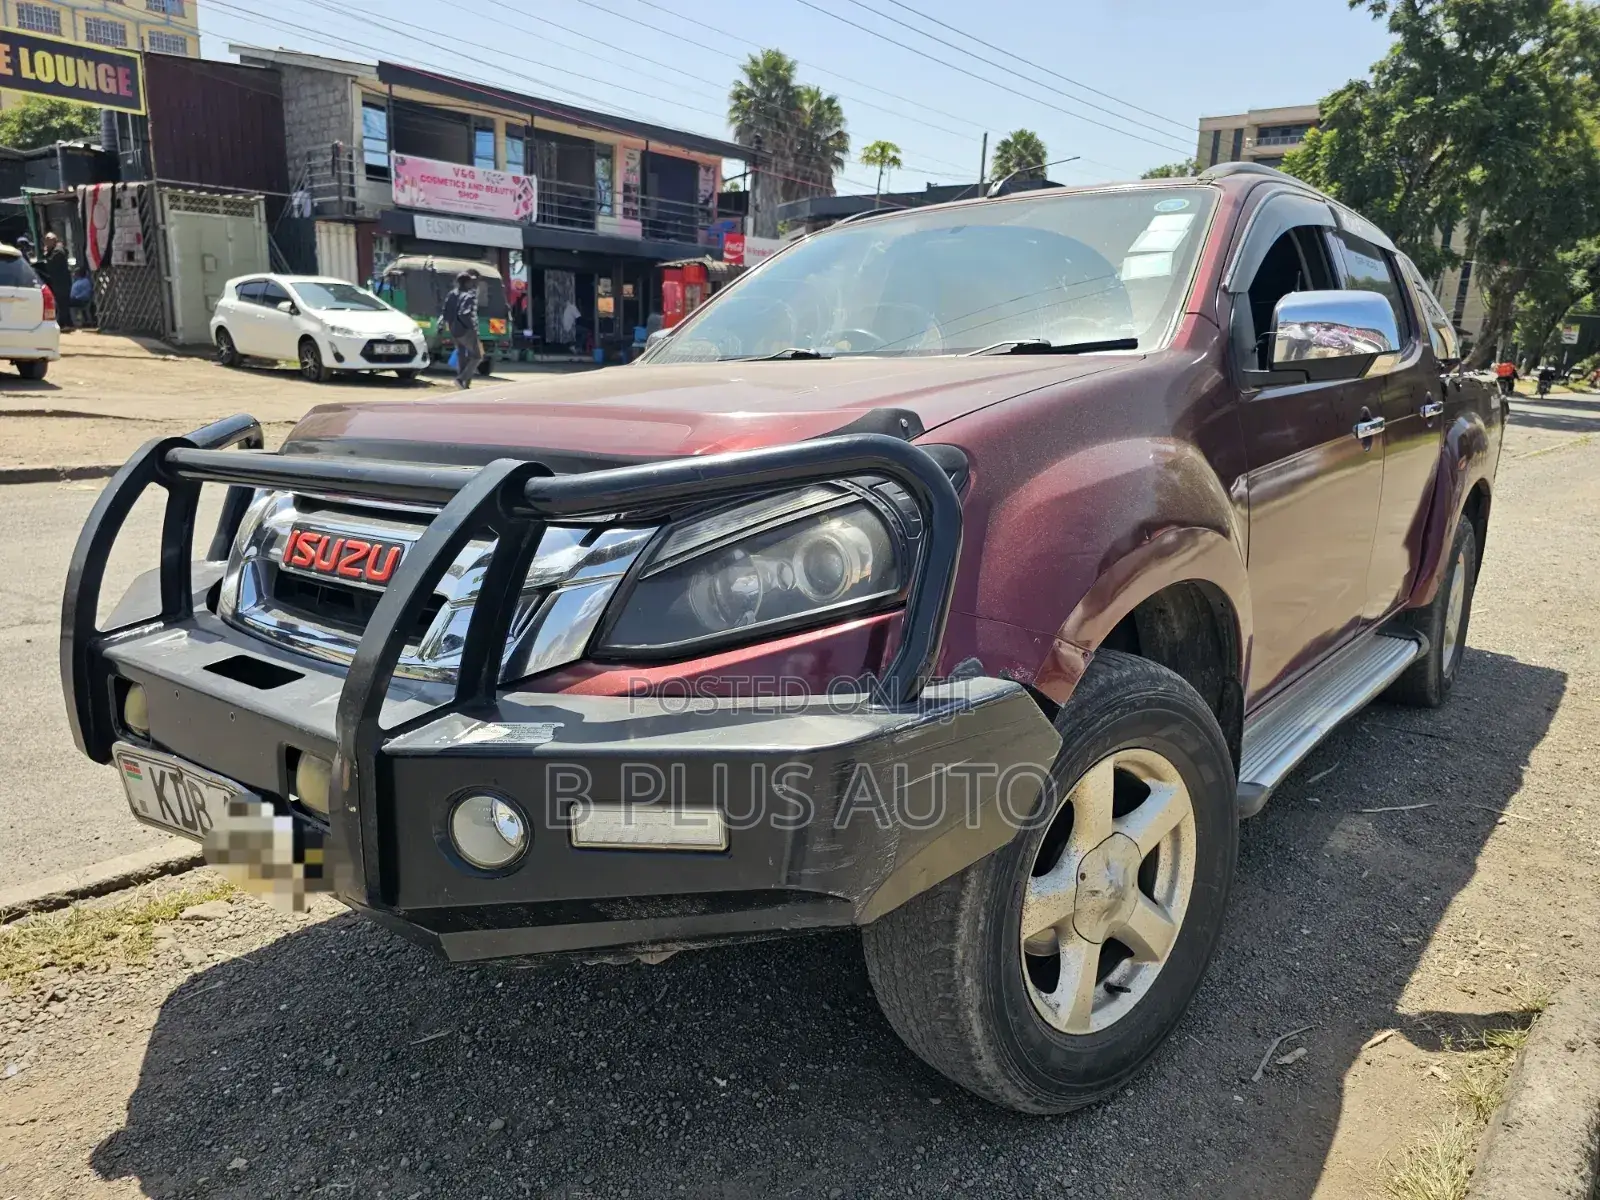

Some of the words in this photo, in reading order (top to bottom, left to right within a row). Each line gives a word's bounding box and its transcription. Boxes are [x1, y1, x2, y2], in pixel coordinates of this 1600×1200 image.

[18, 46, 133, 97] LOUNGE
[452, 167, 476, 180] V&G
[420, 174, 466, 190] COSMETICS
[468, 183, 484, 192] AND
[485, 185, 516, 196] BEAUTY
[457, 190, 480, 200] SHOP
[425, 219, 466, 237] ELSINKI
[283, 529, 401, 583] ISUZU
